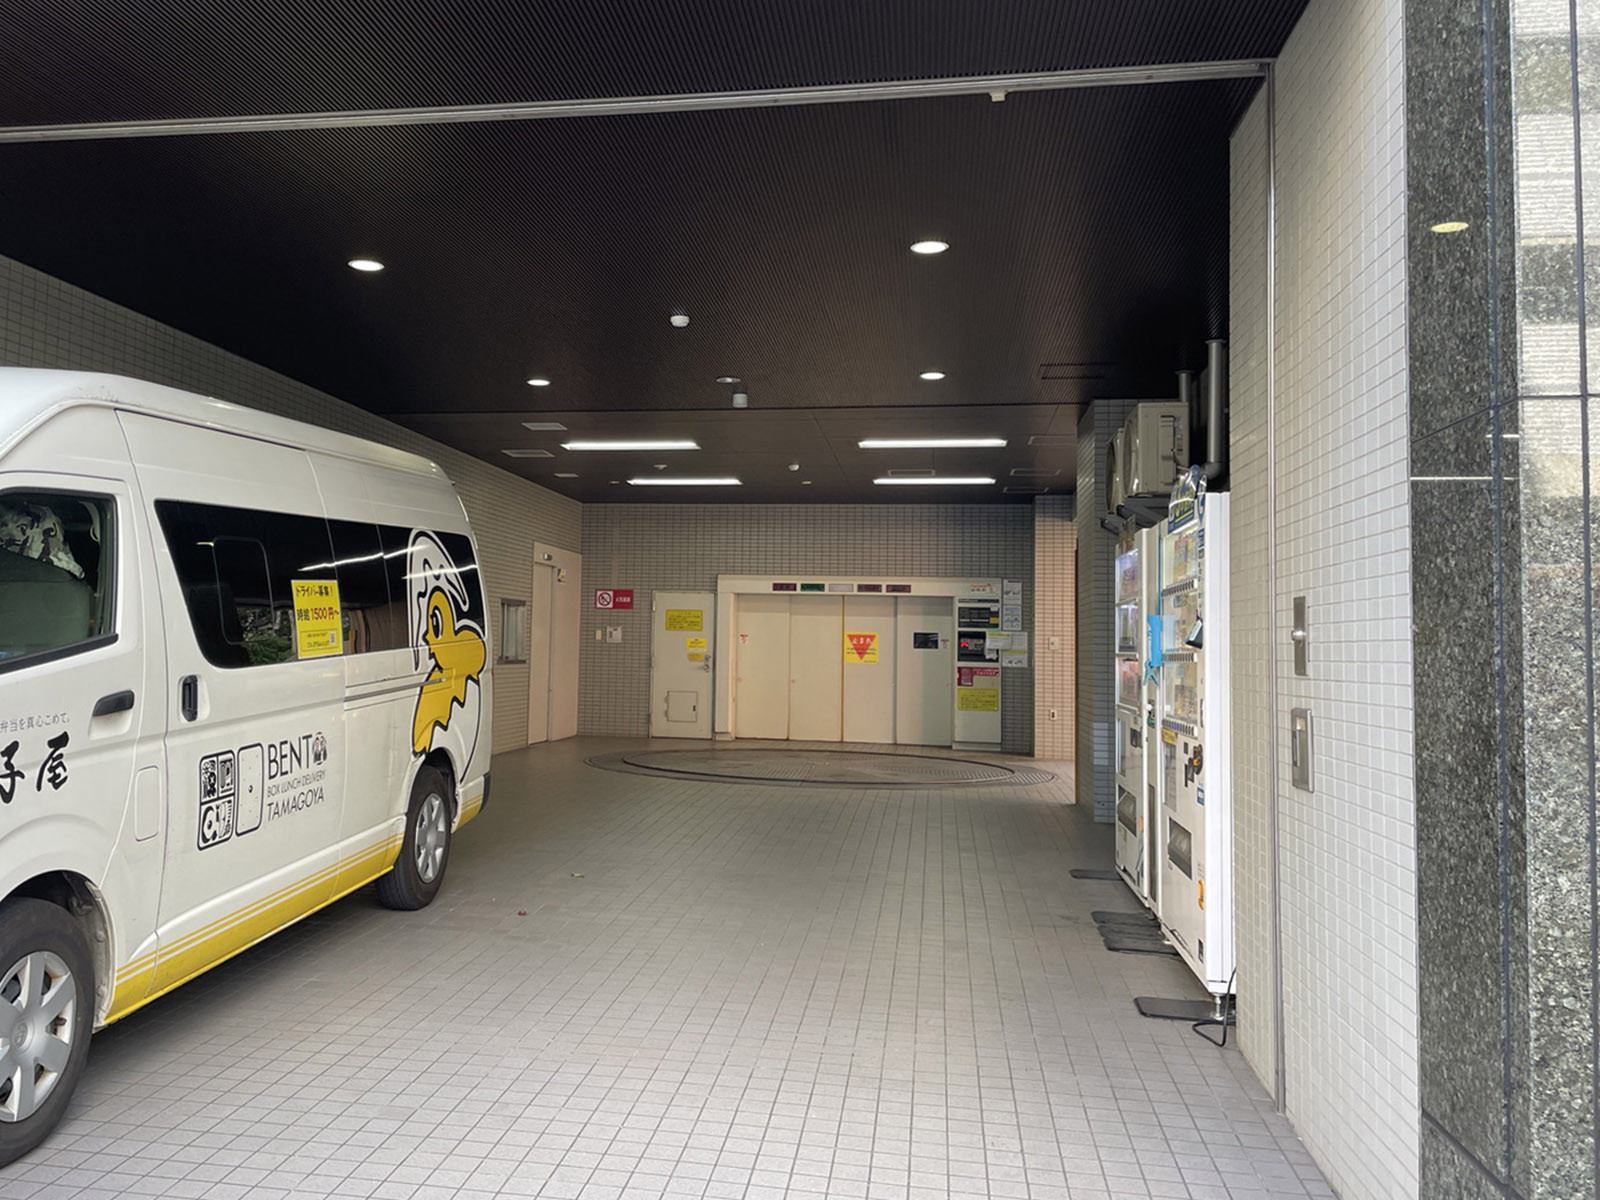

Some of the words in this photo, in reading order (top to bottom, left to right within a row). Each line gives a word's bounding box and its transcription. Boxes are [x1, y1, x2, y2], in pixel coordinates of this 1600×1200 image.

[267, 784, 280, 798] BOX
[281, 777, 301, 793] LUNCH
[302, 770, 326, 787] DELIVERY
[267, 786, 325, 821] TAMAGOYA
